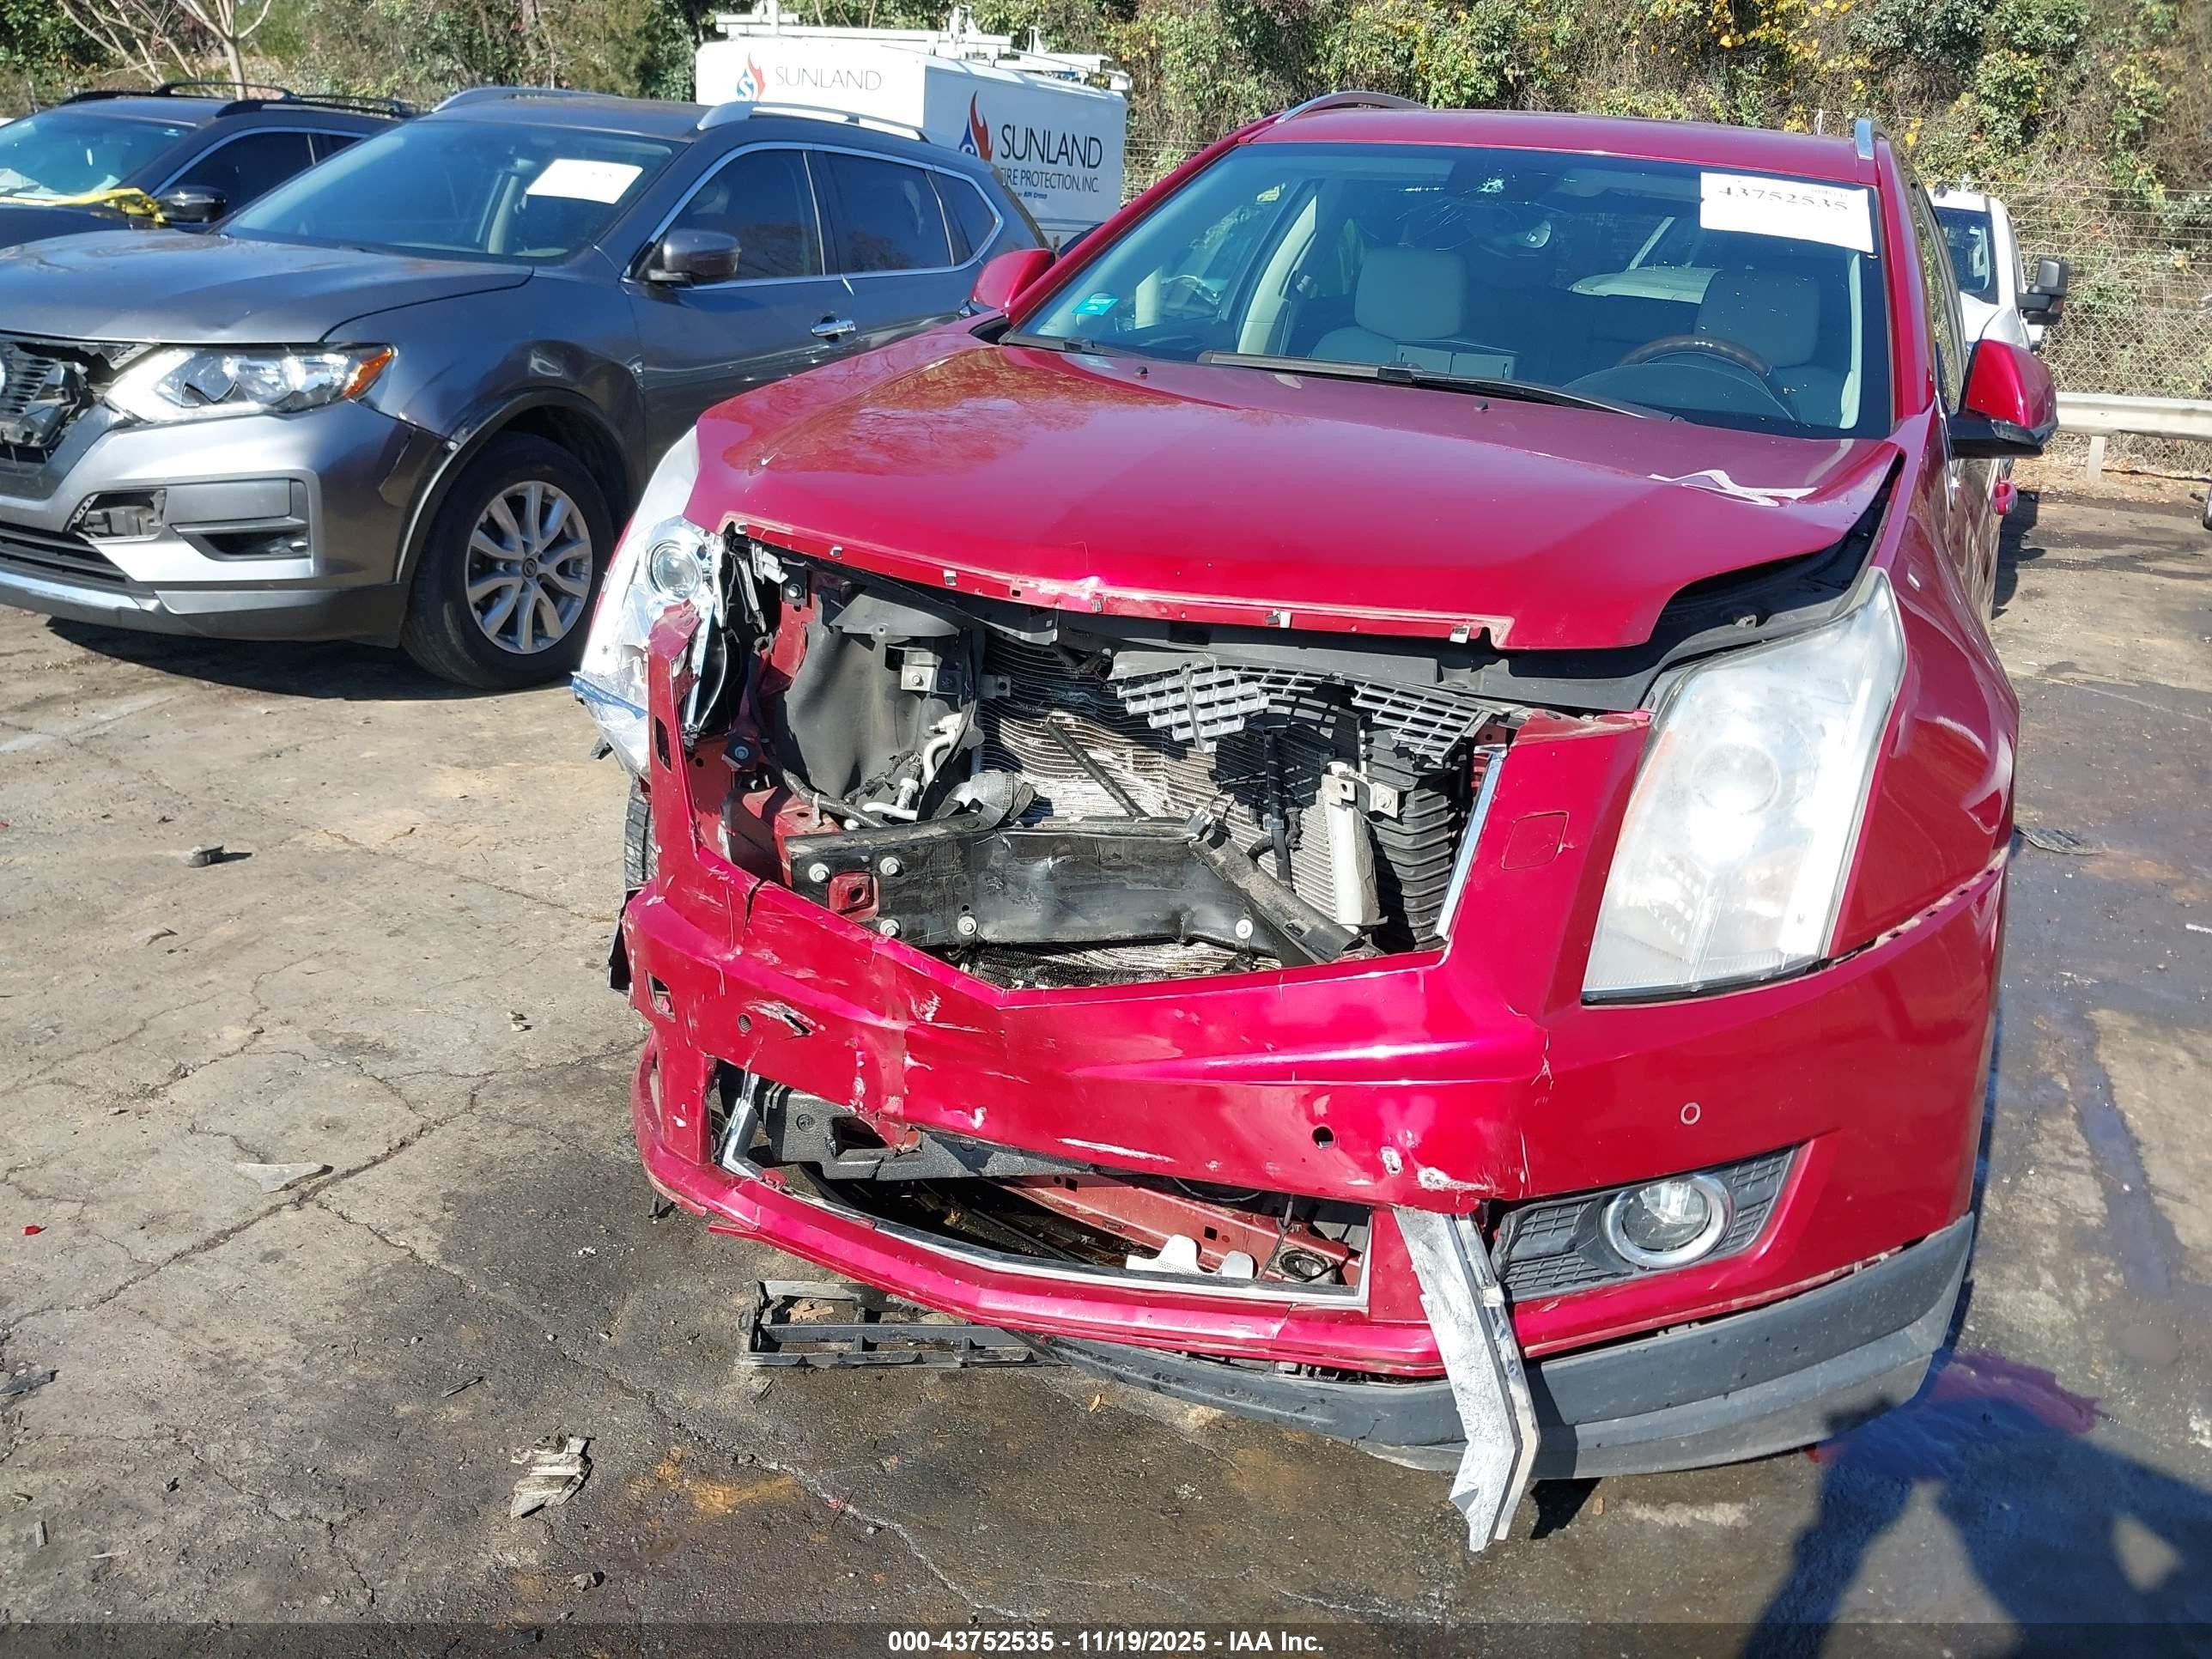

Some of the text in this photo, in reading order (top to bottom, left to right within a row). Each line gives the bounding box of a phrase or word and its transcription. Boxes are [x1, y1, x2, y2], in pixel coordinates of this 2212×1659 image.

[775, 66, 882, 91] SUNLAND
[1000, 124, 1103, 169] SUNLAND
[1082, 174, 1100, 193] INC.
[1718, 185, 1849, 212] 43752535
